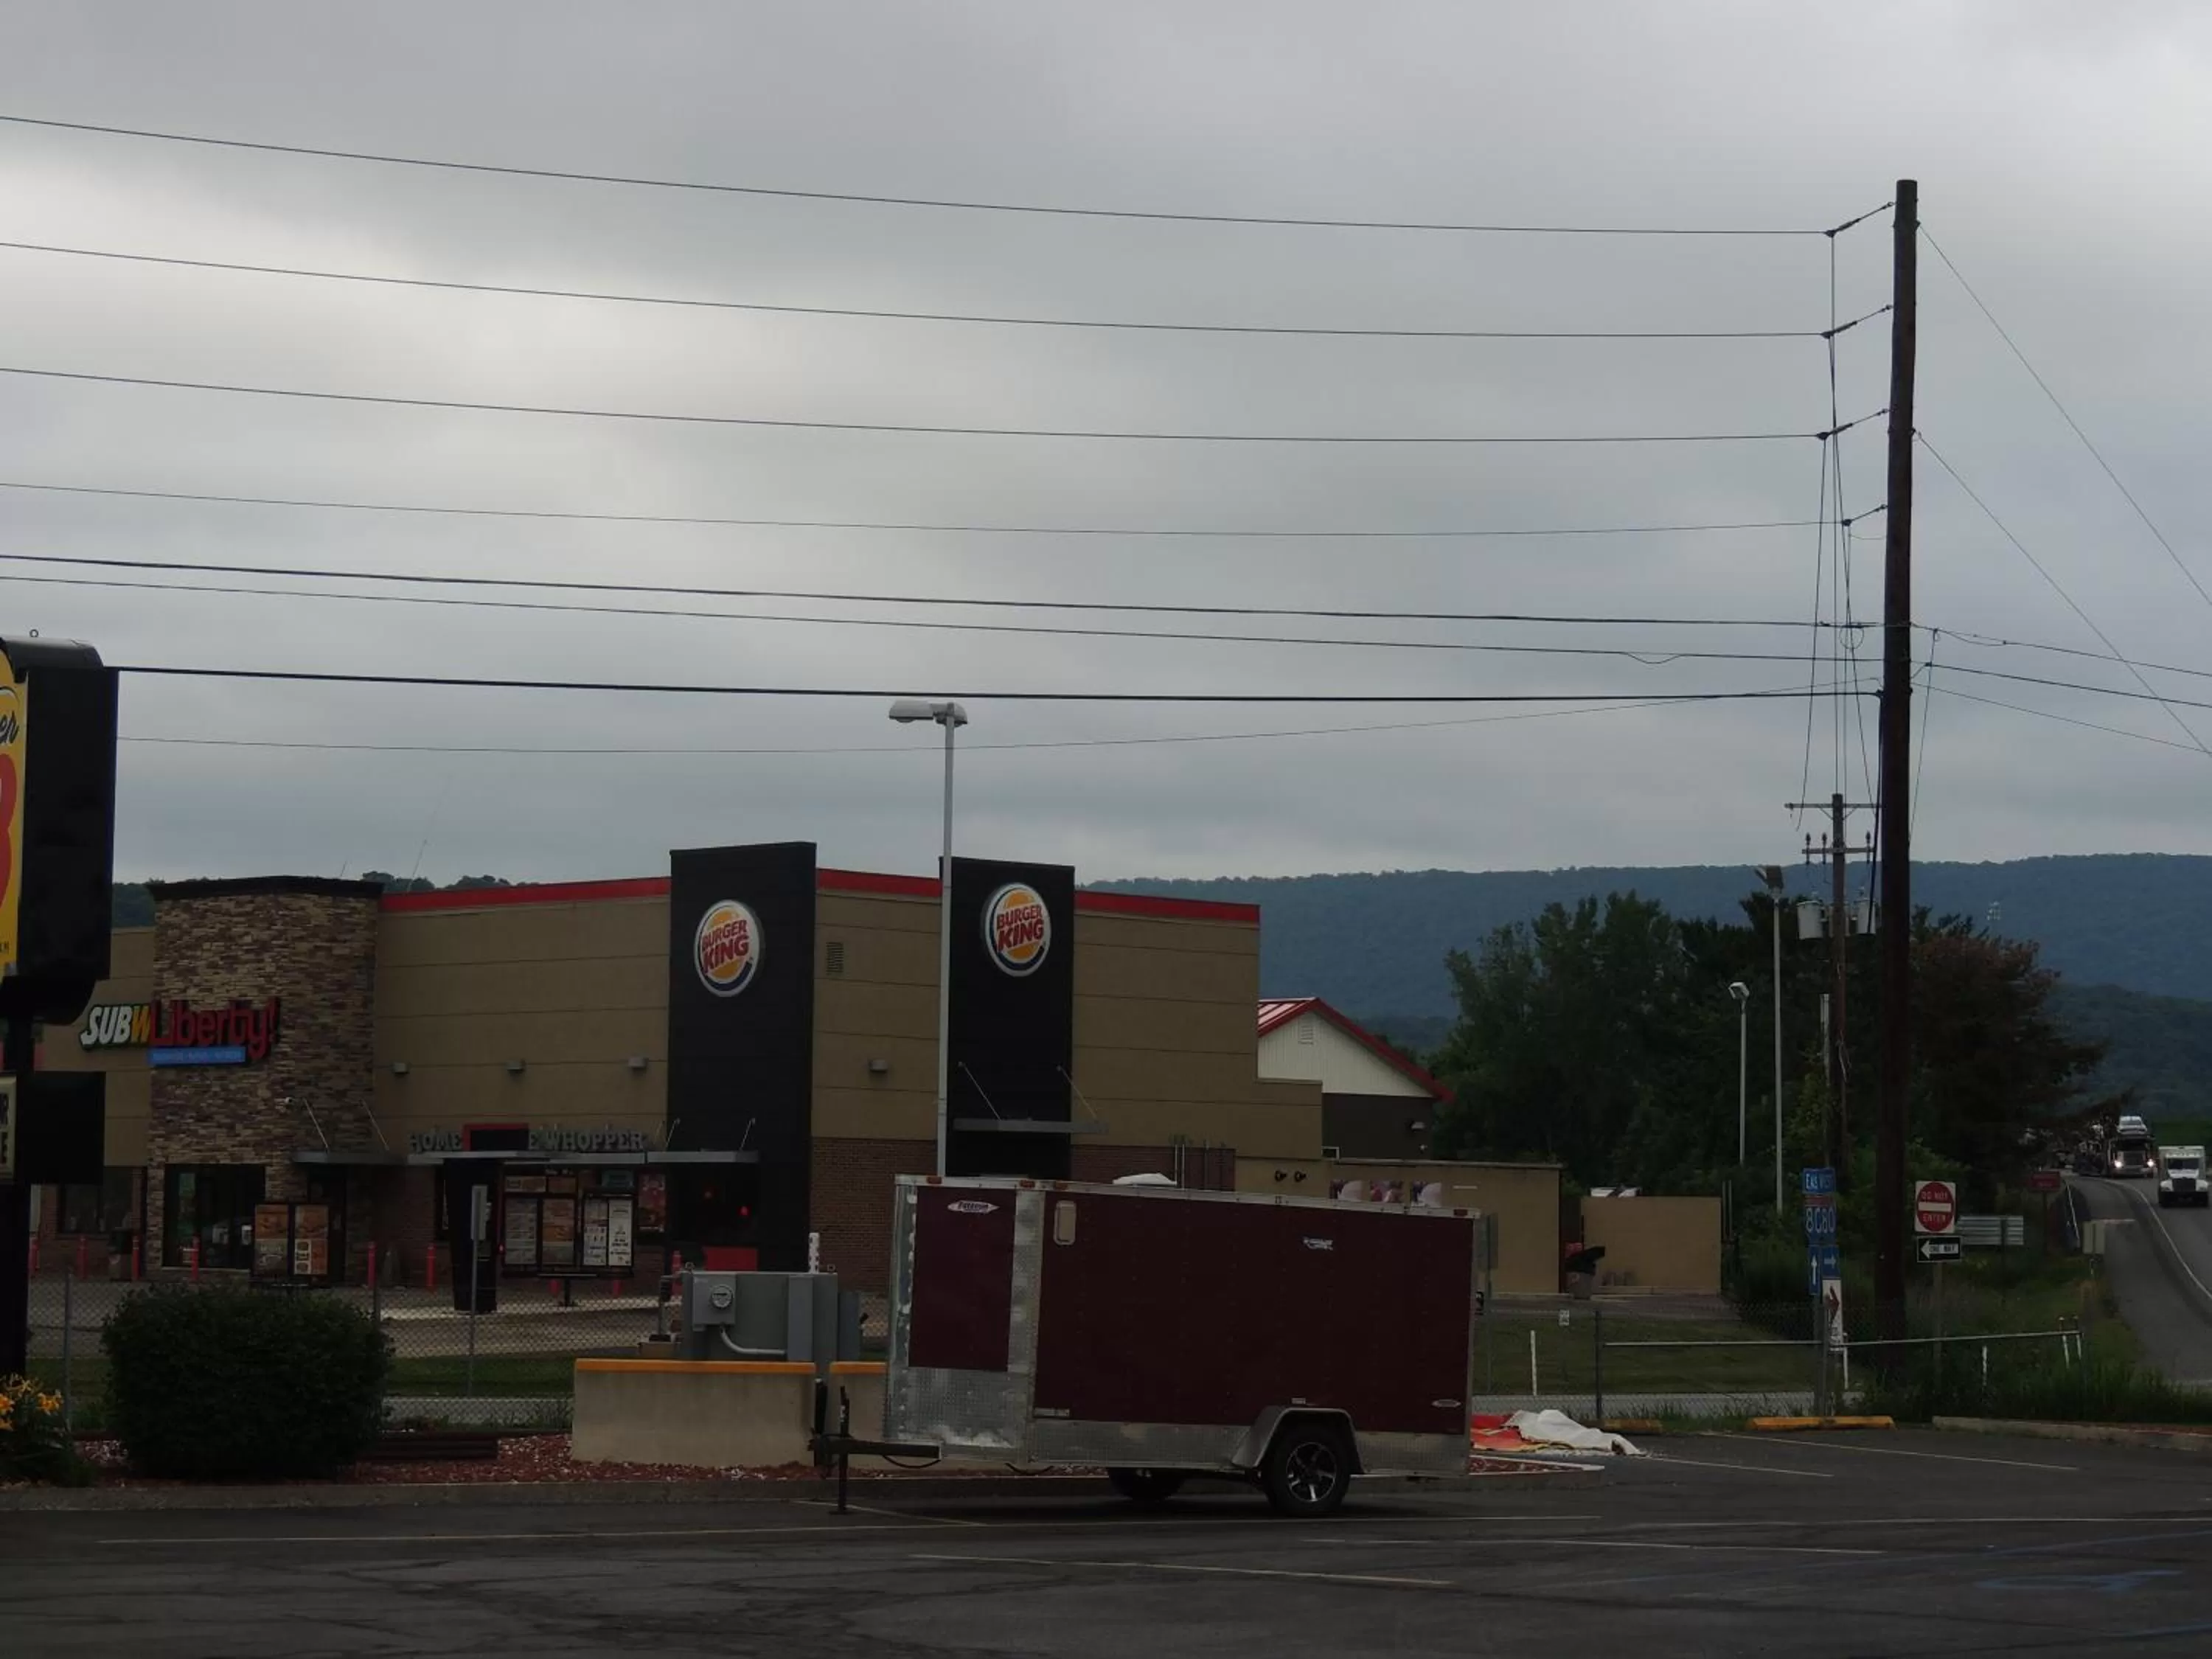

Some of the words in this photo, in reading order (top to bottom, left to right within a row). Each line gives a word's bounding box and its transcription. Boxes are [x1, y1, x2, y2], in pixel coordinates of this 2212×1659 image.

[997, 905, 1043, 929] BURGER
[702, 920, 747, 953] BURGER
[998, 919, 1044, 952] KING
[703, 935, 749, 973] KING
[150, 998, 281, 1060] Liberty!
[411, 1133, 462, 1152] HOME
[545, 1130, 644, 1152] WHOPPER
[1921, 1191, 1933, 1200] DO
